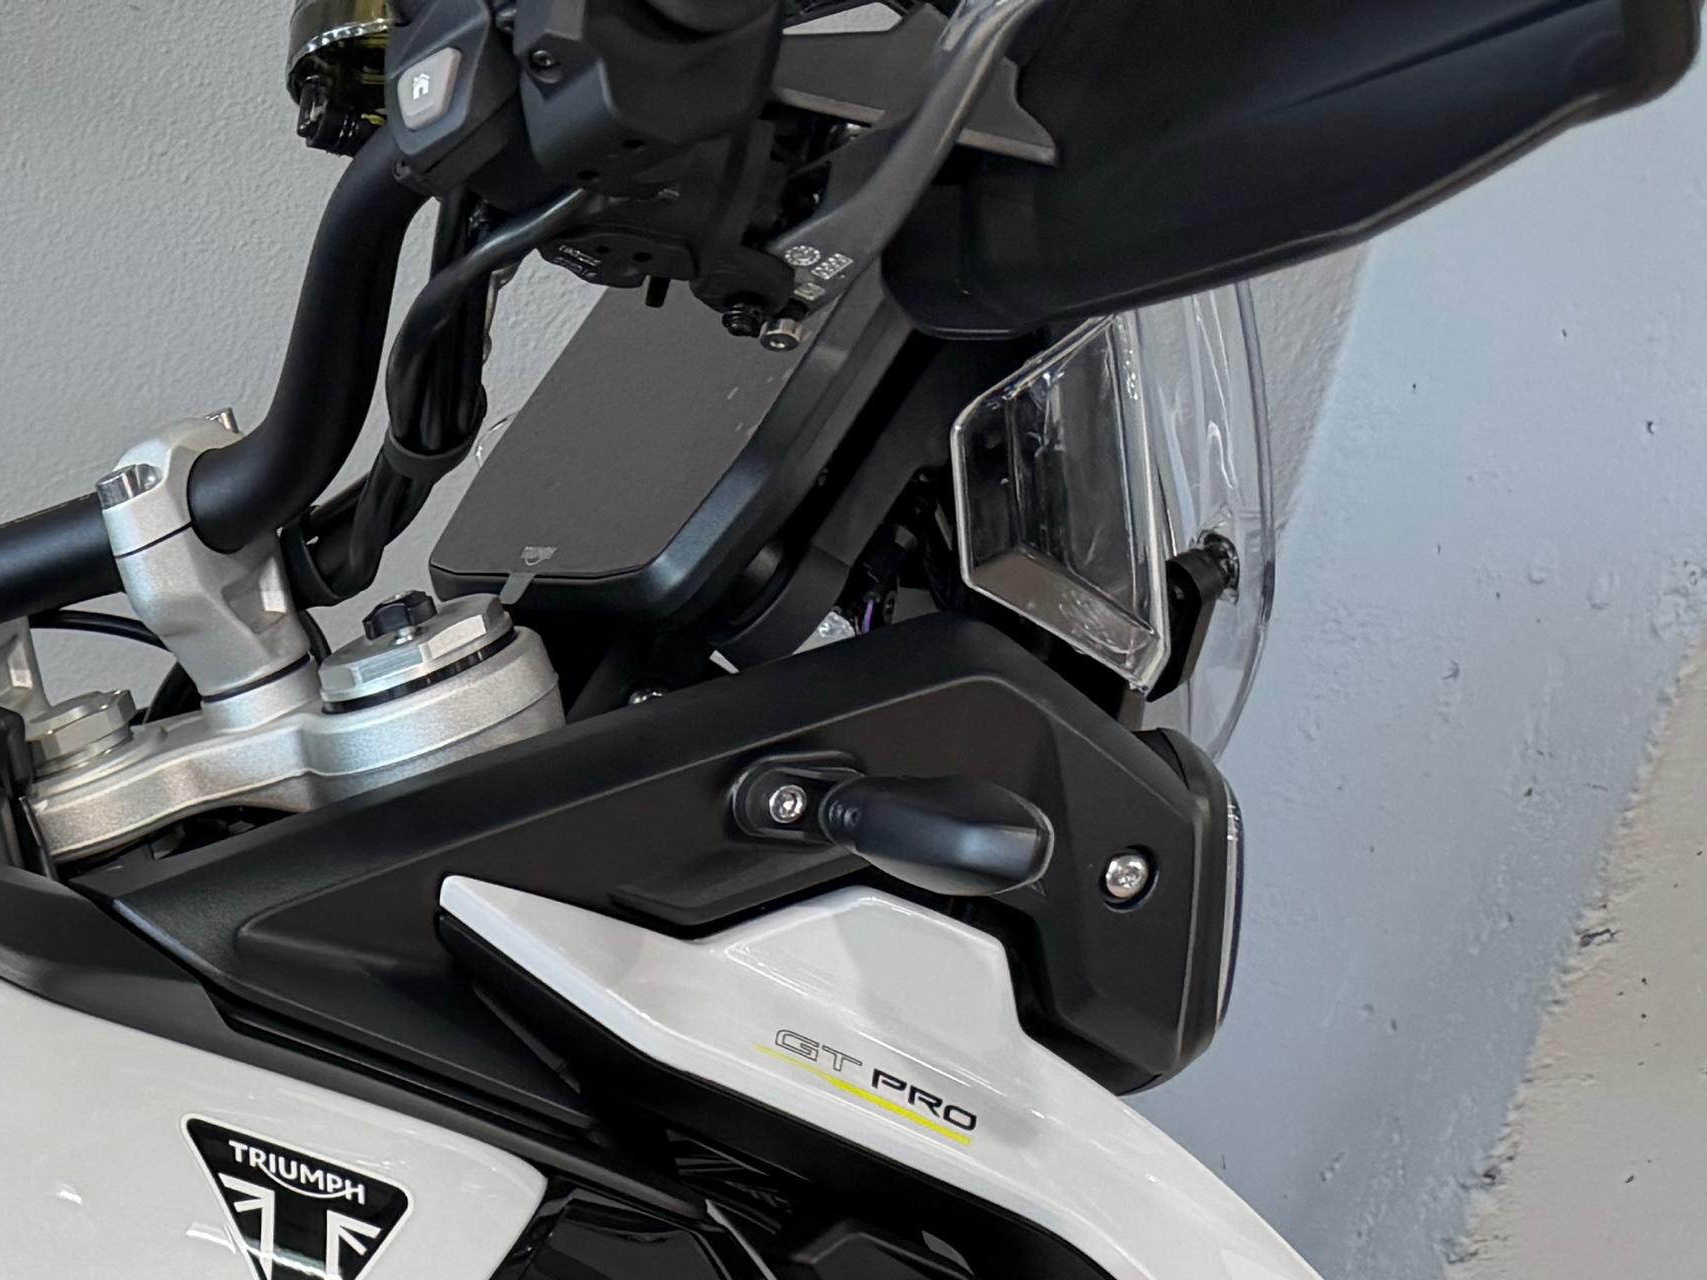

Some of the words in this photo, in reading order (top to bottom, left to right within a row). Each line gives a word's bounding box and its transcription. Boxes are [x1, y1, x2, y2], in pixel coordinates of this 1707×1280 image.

[775, 1029, 863, 1072] GT
[871, 1067, 977, 1131] PRO
[229, 1140, 365, 1205] TRIUMPH
